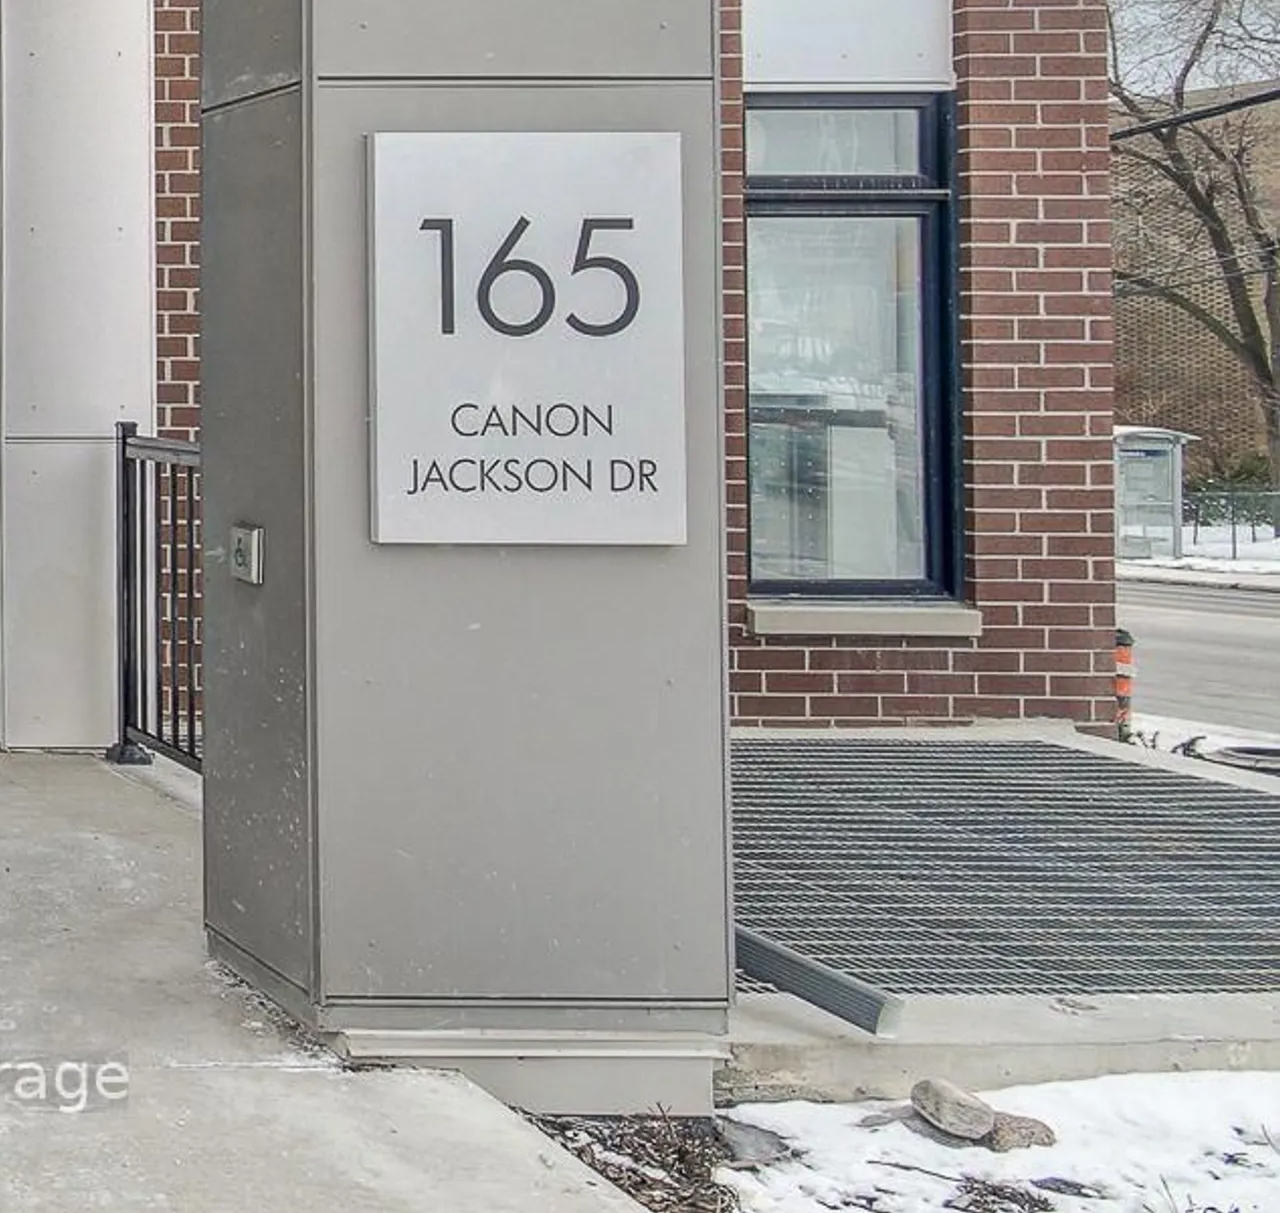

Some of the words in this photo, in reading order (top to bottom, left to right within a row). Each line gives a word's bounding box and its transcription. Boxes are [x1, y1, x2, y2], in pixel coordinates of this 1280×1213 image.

[419, 216, 640, 337] 165
[451, 403, 613, 437] CANON
[407, 459, 593, 495] JACKSON
[610, 459, 658, 492] DR
